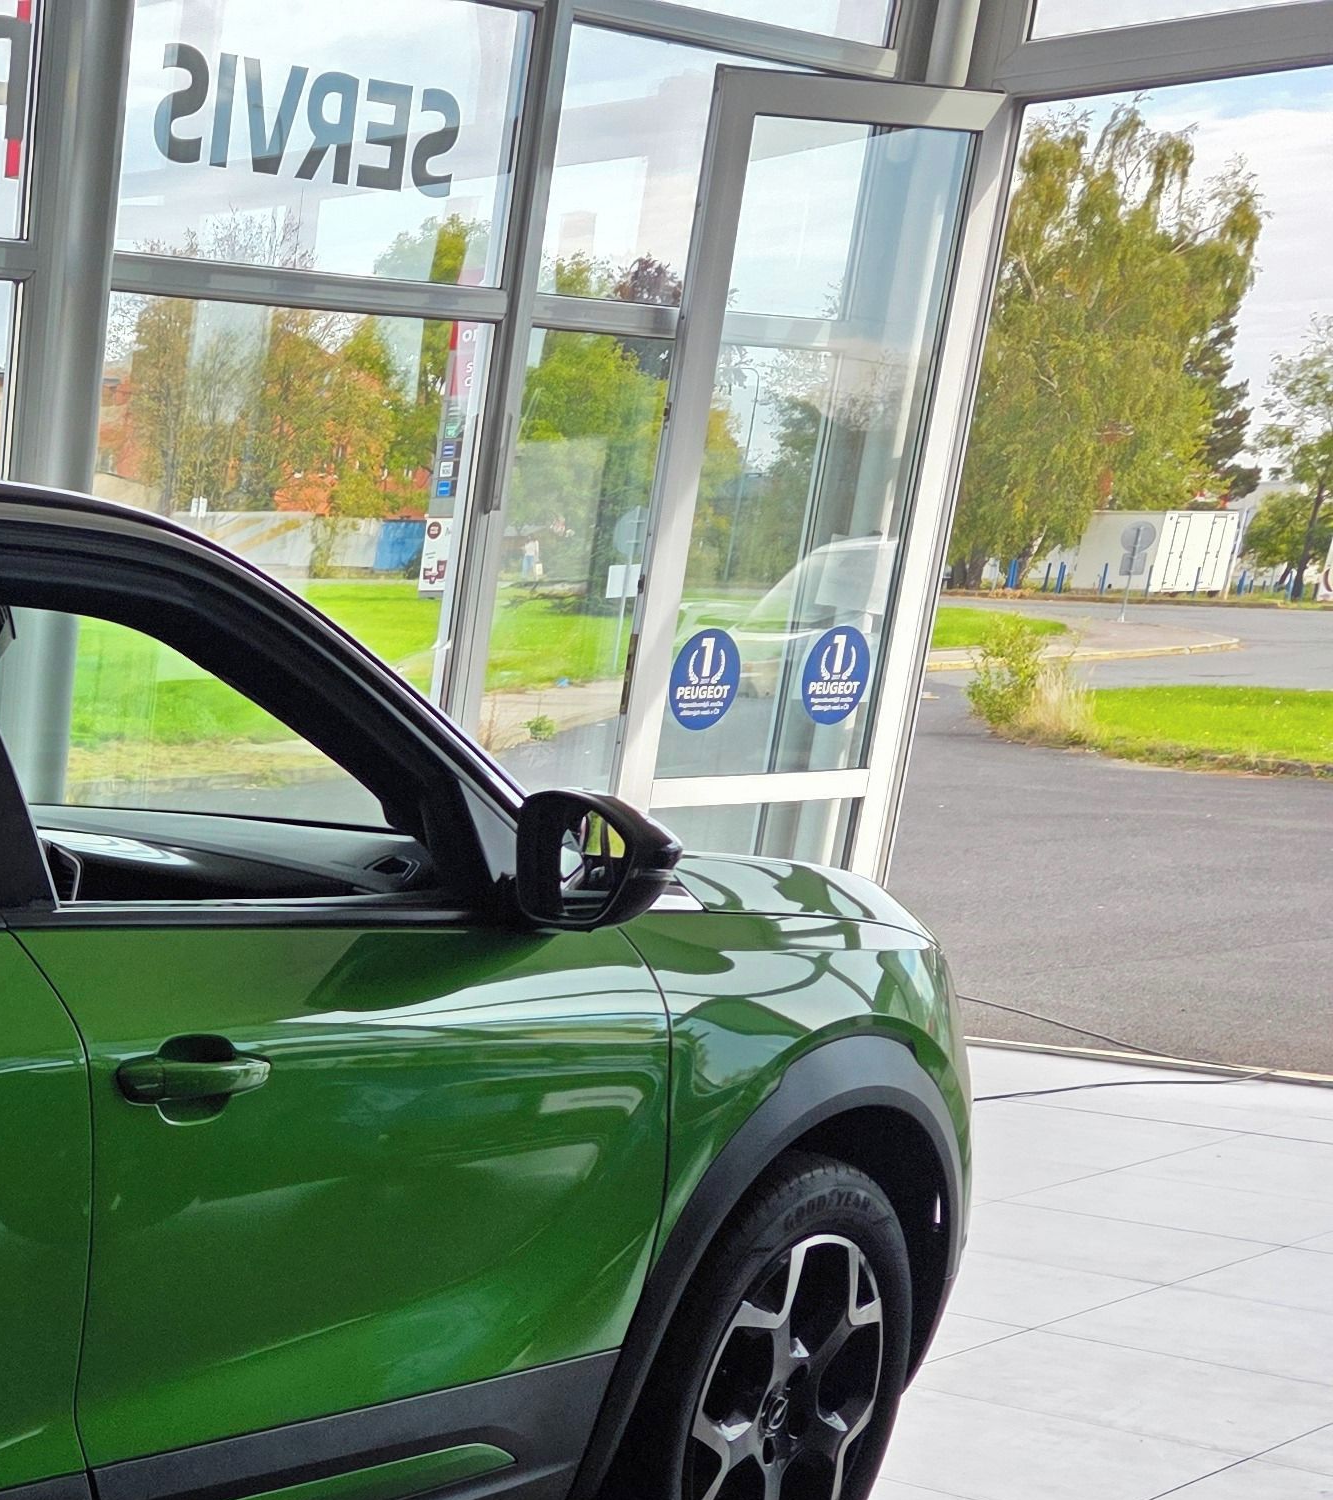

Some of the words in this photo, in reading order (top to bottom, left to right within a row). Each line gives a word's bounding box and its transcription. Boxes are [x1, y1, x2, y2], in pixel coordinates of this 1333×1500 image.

[701, 637, 716, 677] 1
[833, 634, 847, 674] 1
[676, 684, 731, 700] PEUGEOT
[808, 681, 861, 695] PEUGEOT
